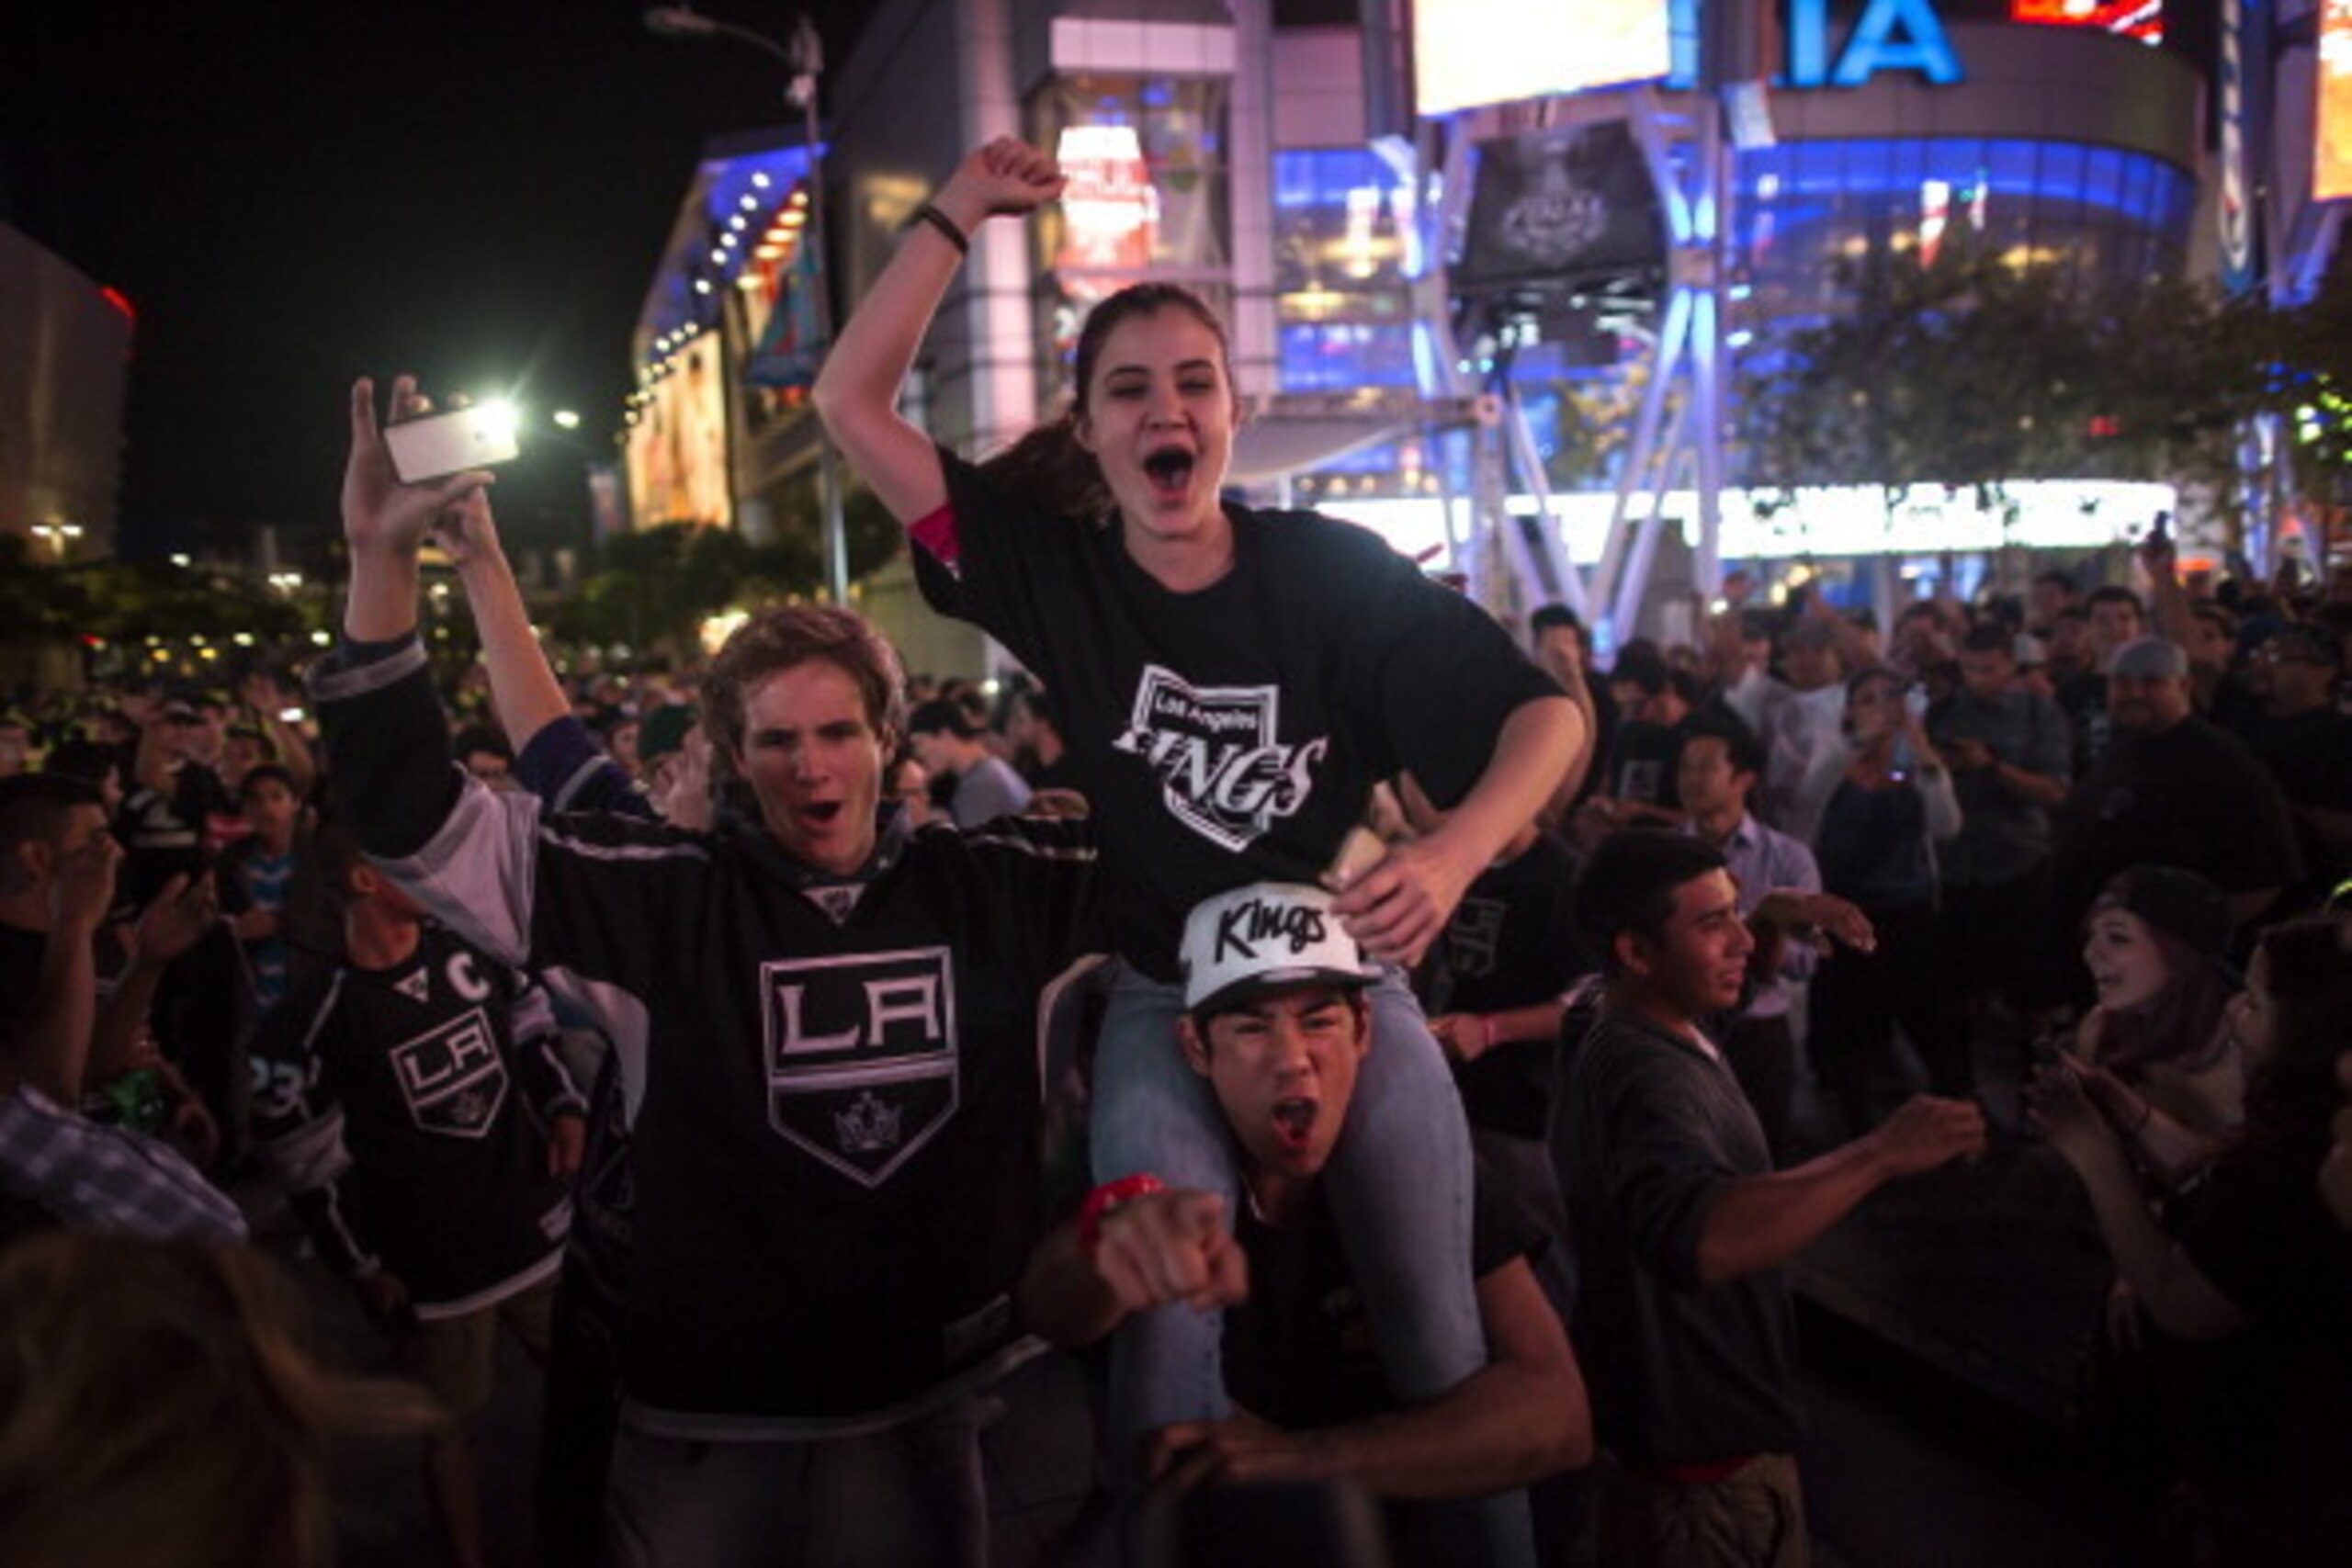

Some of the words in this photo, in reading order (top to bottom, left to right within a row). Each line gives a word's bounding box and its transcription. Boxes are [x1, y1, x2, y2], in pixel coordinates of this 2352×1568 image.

[1215, 897, 1327, 964] Kings
[446, 950, 492, 1001] C
[777, 974, 941, 1055] LA
[402, 1024, 490, 1091] LA
